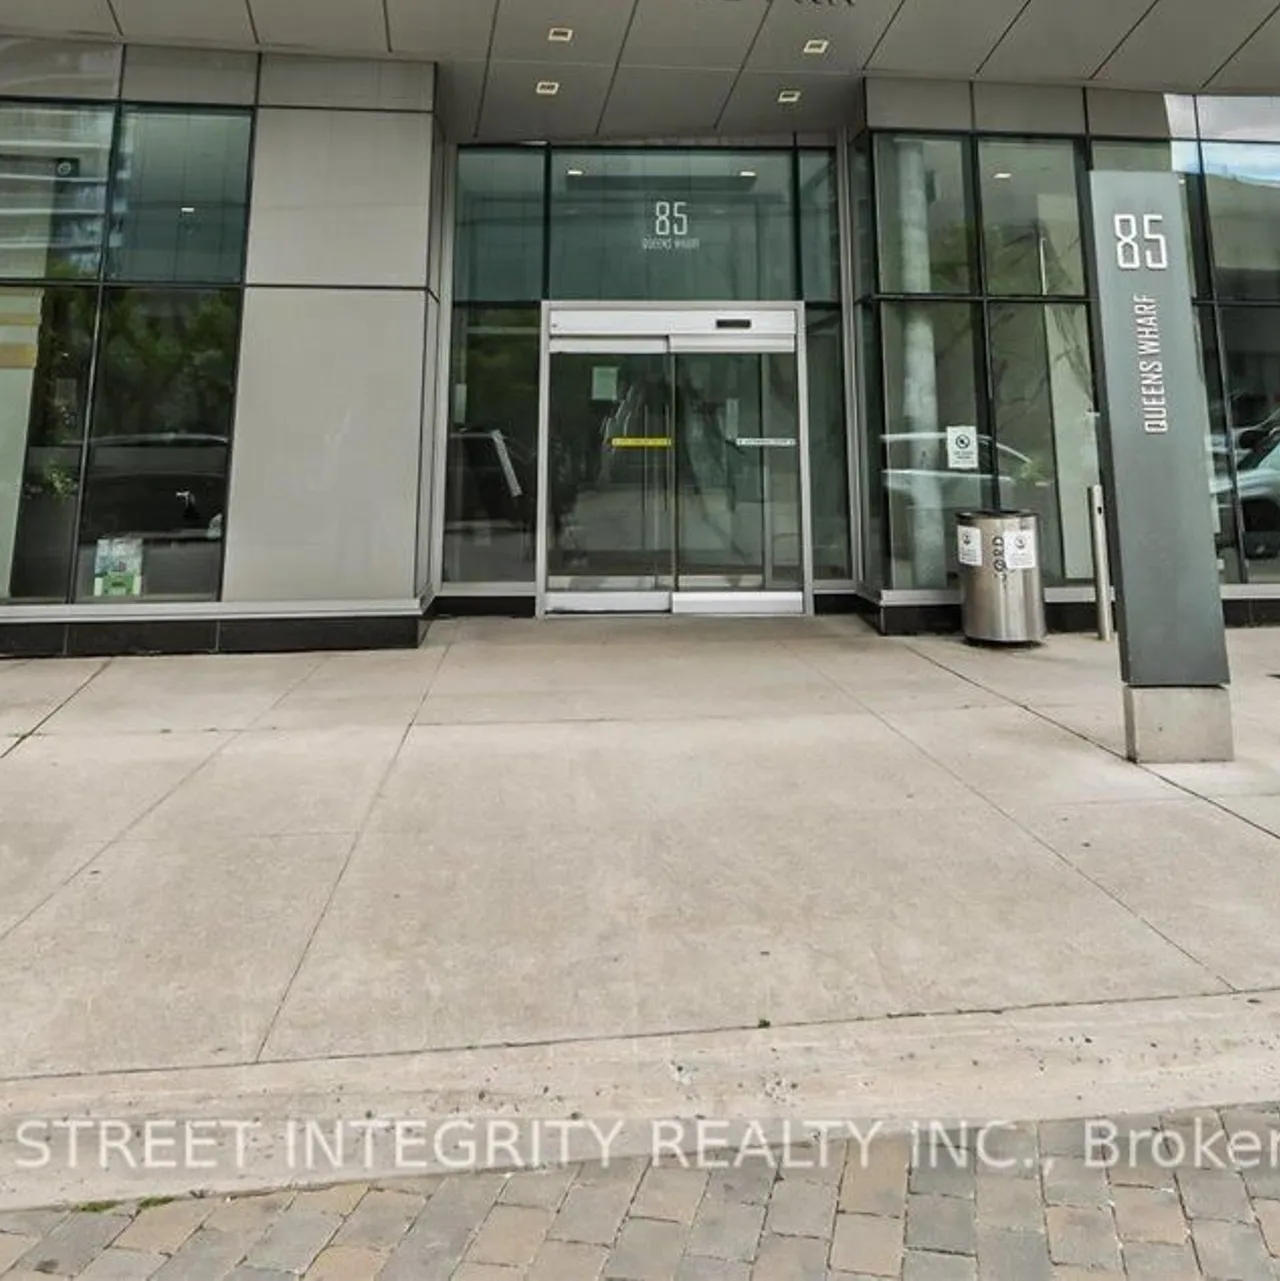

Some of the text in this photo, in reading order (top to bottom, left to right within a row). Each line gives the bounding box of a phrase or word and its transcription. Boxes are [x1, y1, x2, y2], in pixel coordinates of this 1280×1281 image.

[656, 201, 688, 235] 85
[1113, 213, 1168, 269] 85
[1133, 293, 1168, 434] QUEENS WHARF
